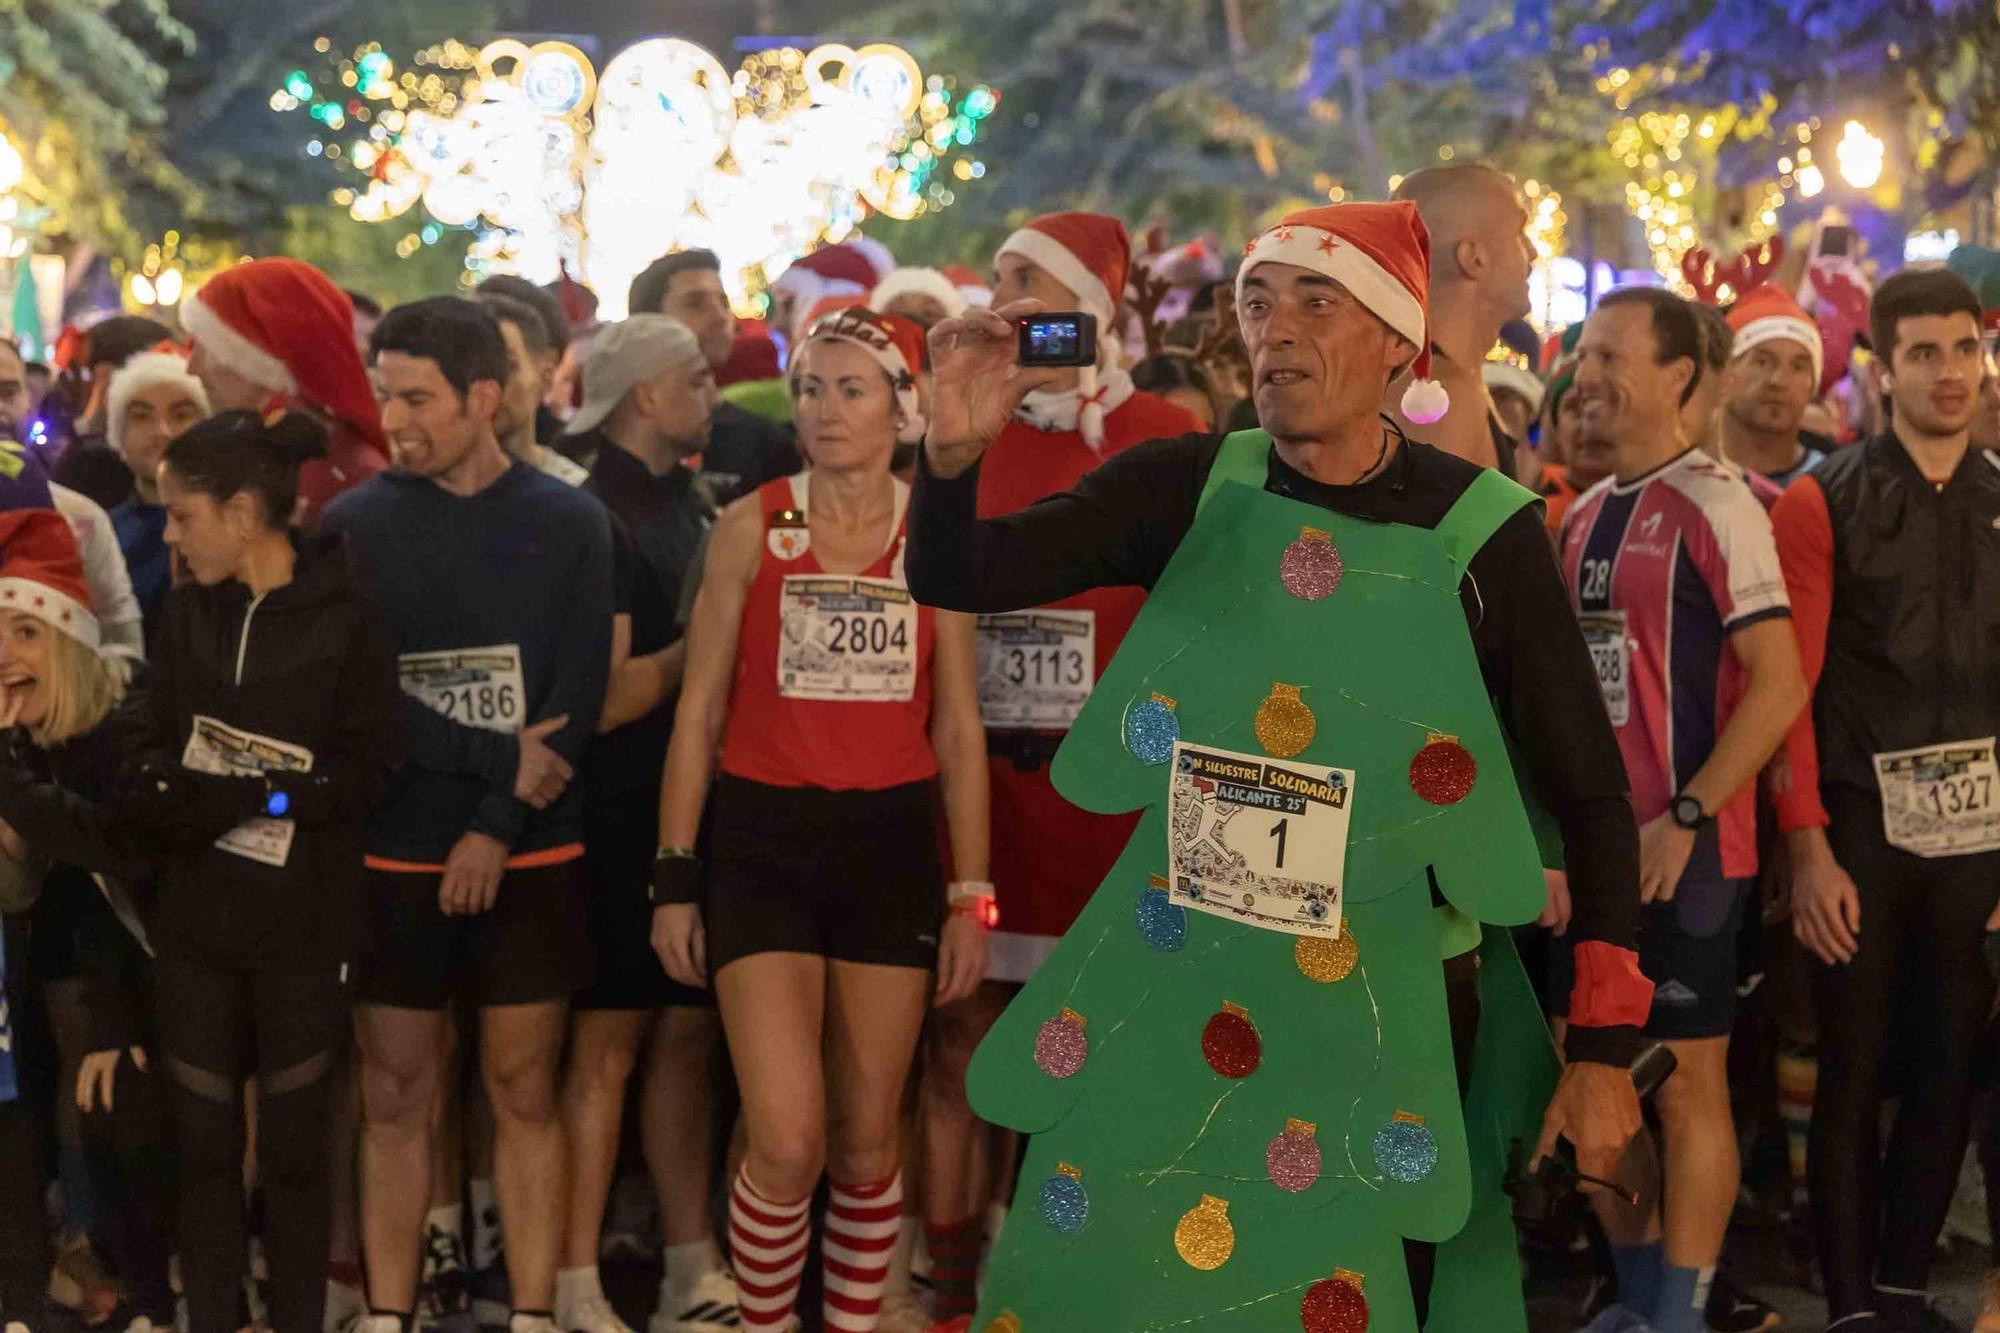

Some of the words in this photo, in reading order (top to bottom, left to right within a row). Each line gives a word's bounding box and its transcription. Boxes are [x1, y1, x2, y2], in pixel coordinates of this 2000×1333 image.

[1582, 558, 1610, 600] 28
[829, 616, 907, 655] 2804
[1010, 648, 1083, 685] 3113
[440, 685, 514, 721] 2186
[1205, 760, 1259, 781] SILVESTRE
[1269, 771, 1341, 803] SOLIDARIA
[1219, 786, 1281, 808] ALICANTE
[1929, 775, 1991, 817] 1327
[1270, 818, 1288, 869] 1
